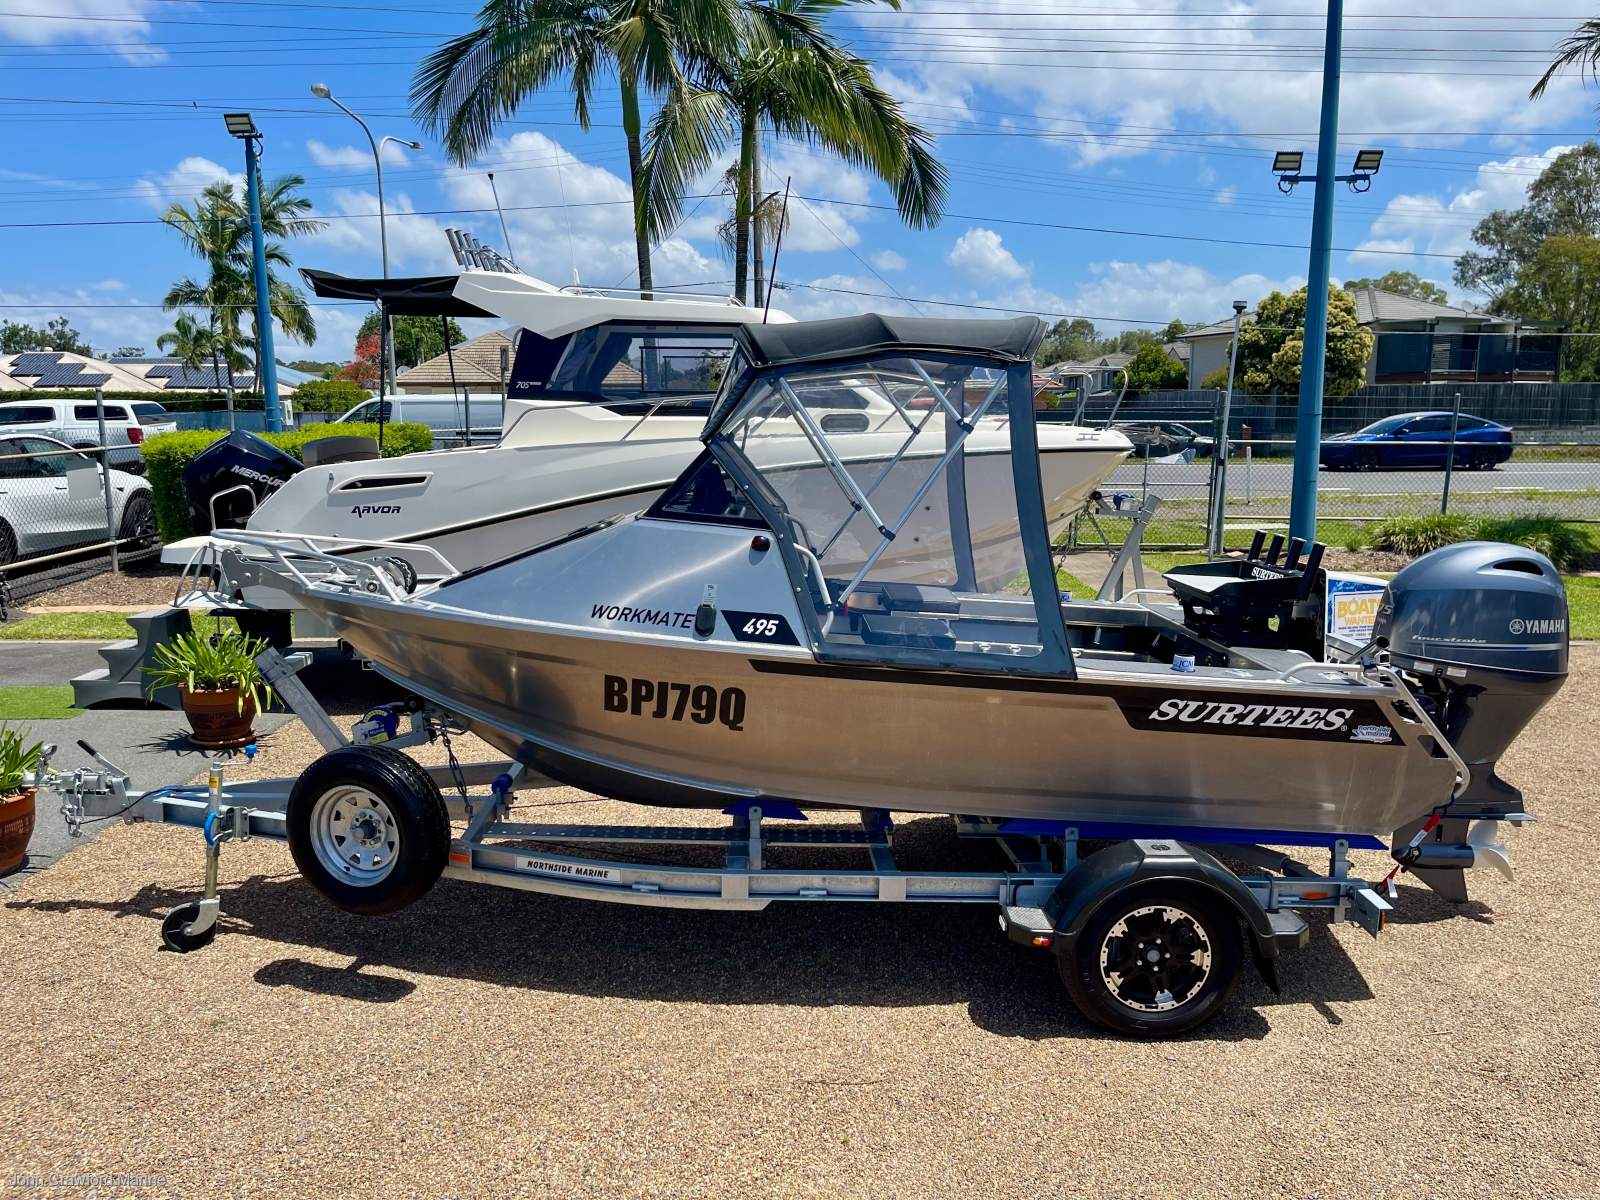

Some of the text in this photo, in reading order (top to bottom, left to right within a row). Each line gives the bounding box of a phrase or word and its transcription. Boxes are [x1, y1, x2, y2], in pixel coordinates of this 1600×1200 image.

[515, 381, 529, 389] 705
[230, 464, 285, 487] MERCUR
[351, 505, 402, 518] ARVOR
[591, 604, 695, 629] WORKMATE
[1344, 614, 1376, 626] WANTE
[1525, 619, 1565, 633] YAMAHA
[742, 618, 779, 637] 495
[603, 674, 747, 731] BPJ79Q
[1148, 699, 1354, 731] SURTEES
[527, 860, 609, 879] NORTHSIDE MARINE
